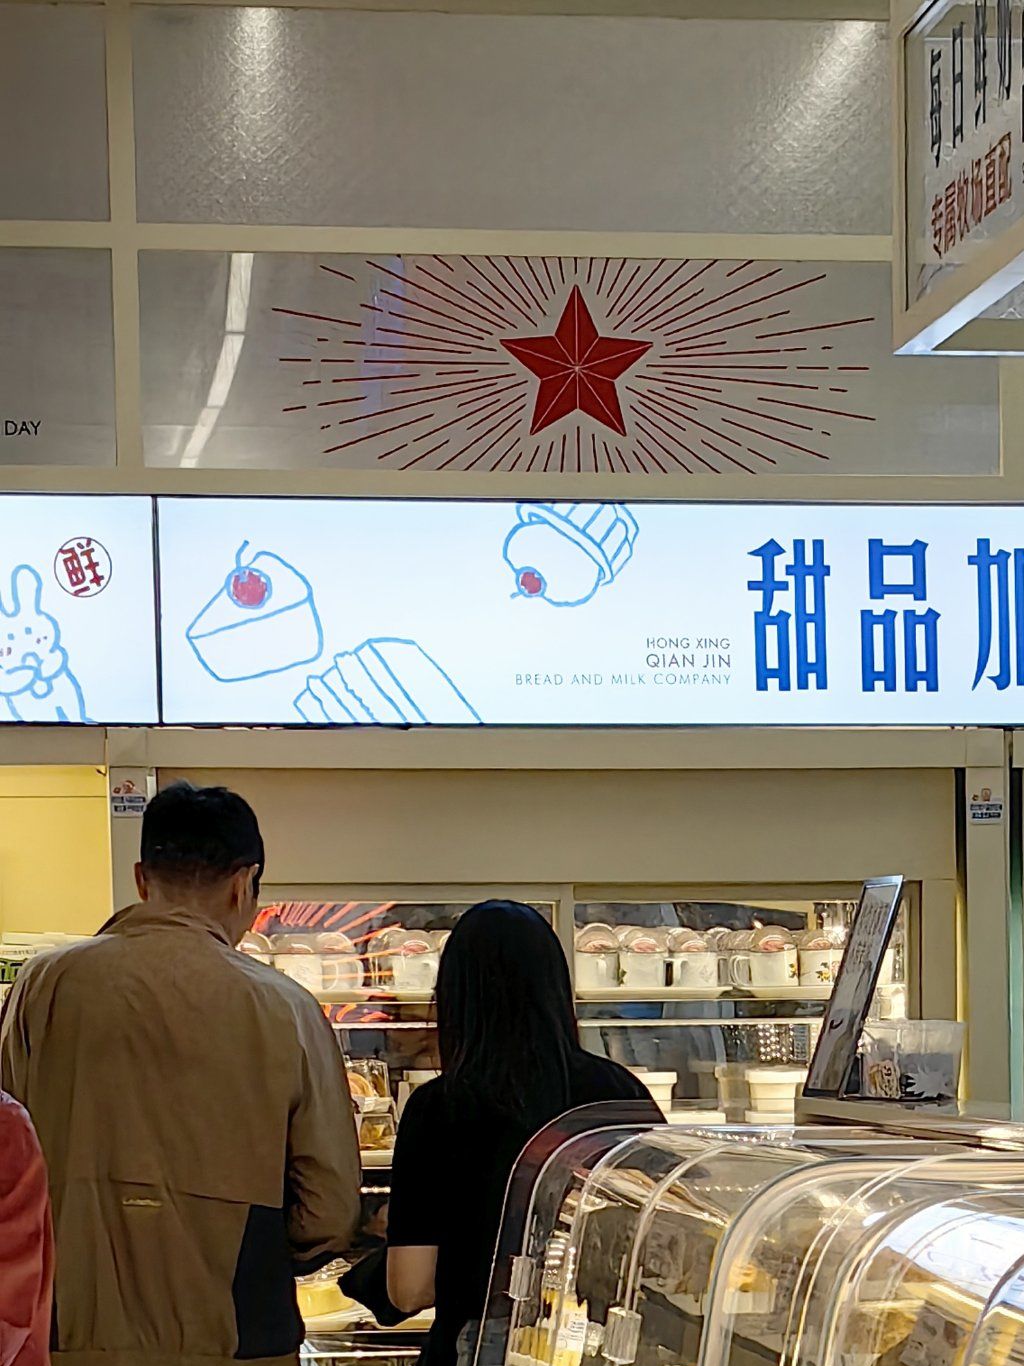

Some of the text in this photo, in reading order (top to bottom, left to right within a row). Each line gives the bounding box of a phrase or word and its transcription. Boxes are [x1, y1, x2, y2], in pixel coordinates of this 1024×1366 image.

[4, 420, 41, 437] DAY
[646, 637, 731, 649] HONG XING
[646, 653, 731, 669] QIAN JIN
[515, 672, 732, 686] BREAD AND MILK COMPANY
